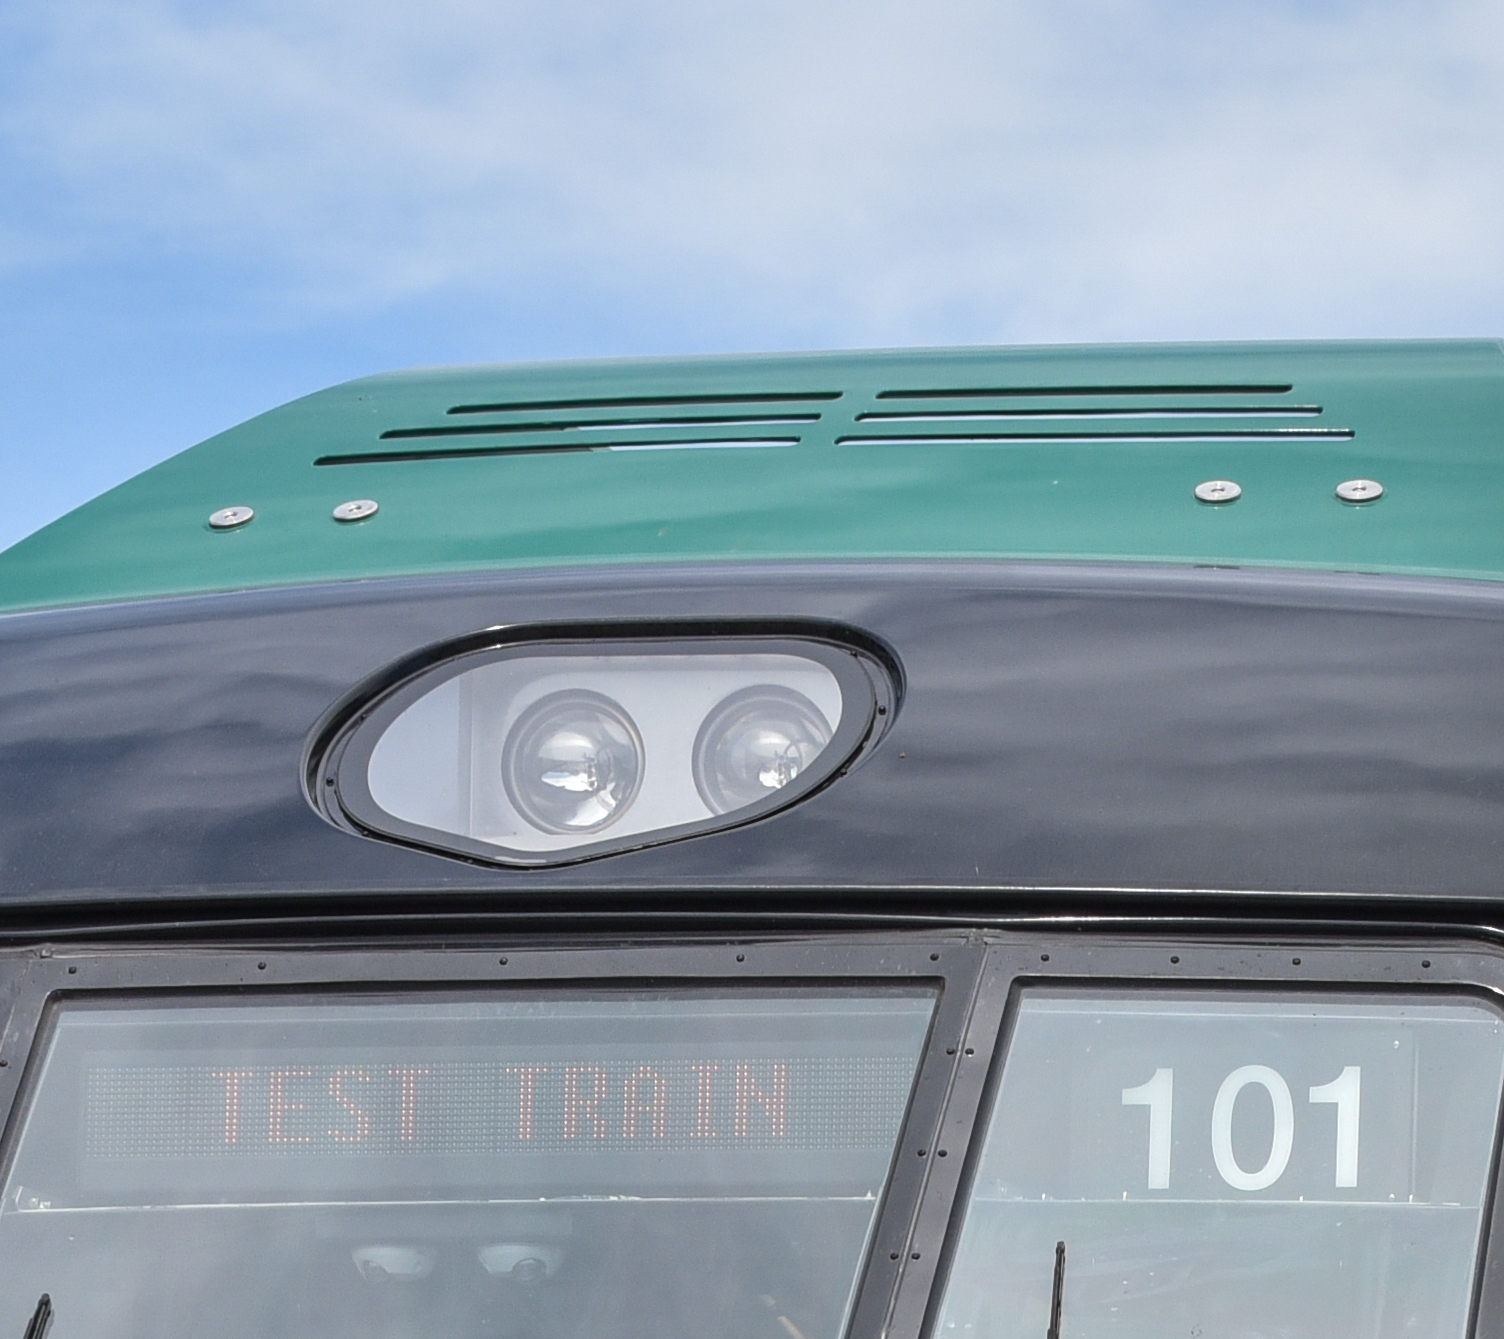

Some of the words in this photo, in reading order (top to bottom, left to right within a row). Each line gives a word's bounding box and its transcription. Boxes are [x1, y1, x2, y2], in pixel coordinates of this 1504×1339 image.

[211, 1068, 430, 1143] TEST
[505, 1064, 786, 1140] TRAIN
[1120, 1064, 1362, 1193] 101
